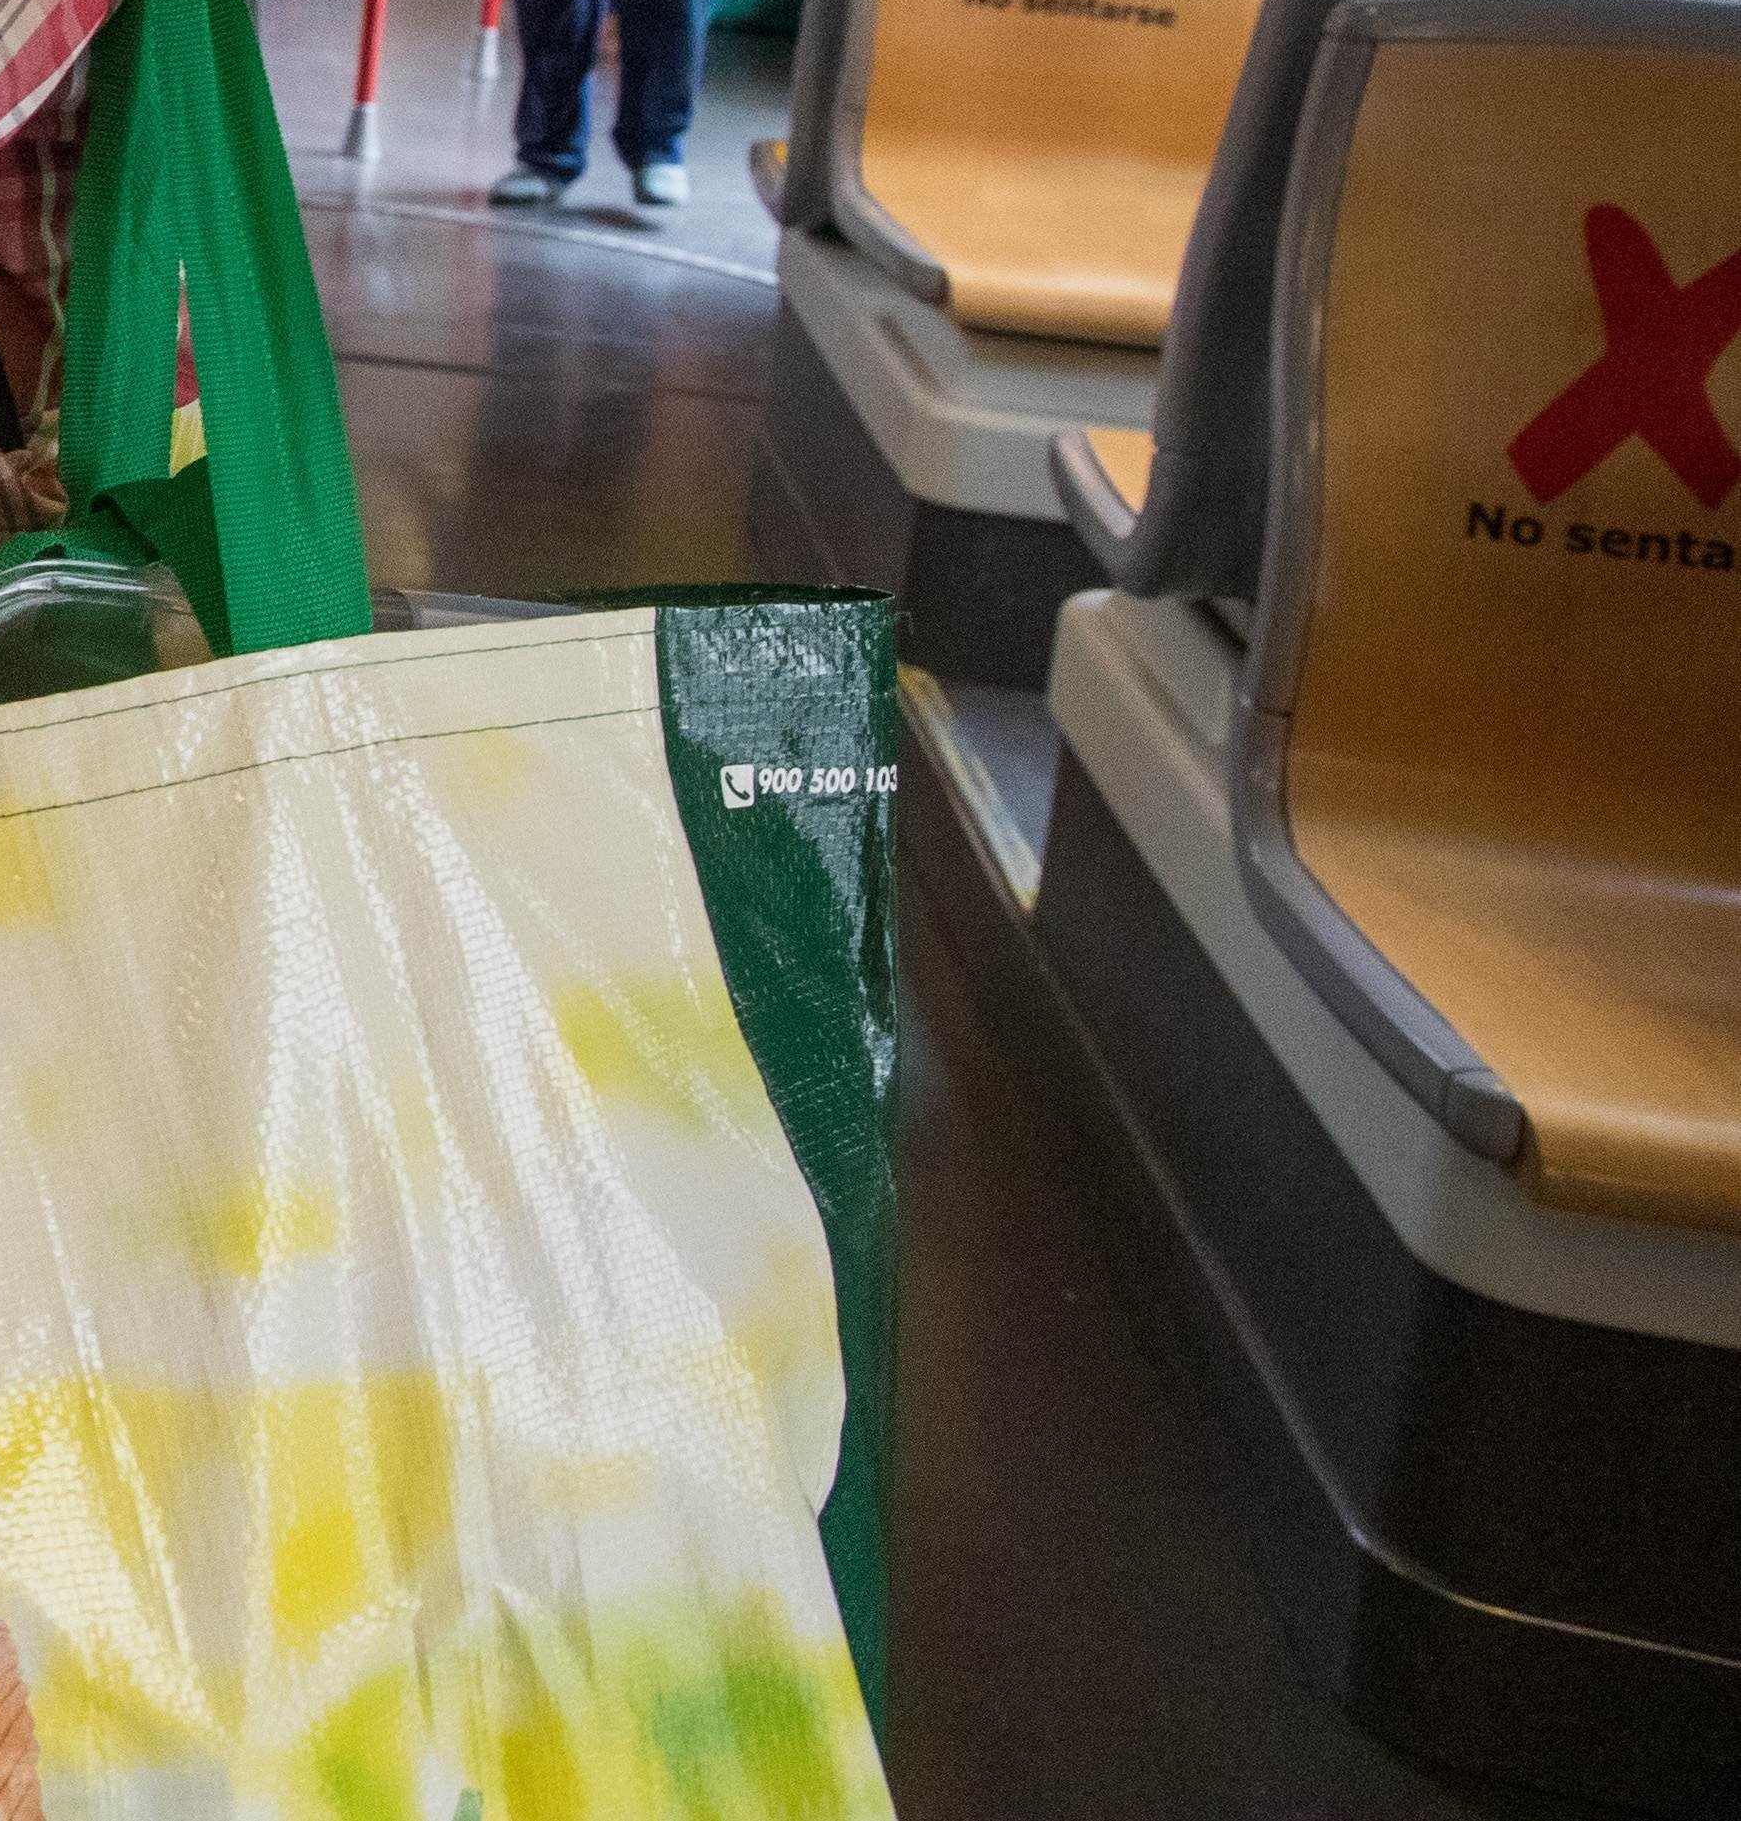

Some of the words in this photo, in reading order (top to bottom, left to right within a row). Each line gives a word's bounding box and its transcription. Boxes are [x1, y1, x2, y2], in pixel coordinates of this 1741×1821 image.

[1467, 501, 1544, 547] No
[758, 767, 803, 794] 900
[809, 767, 856, 794] 500
